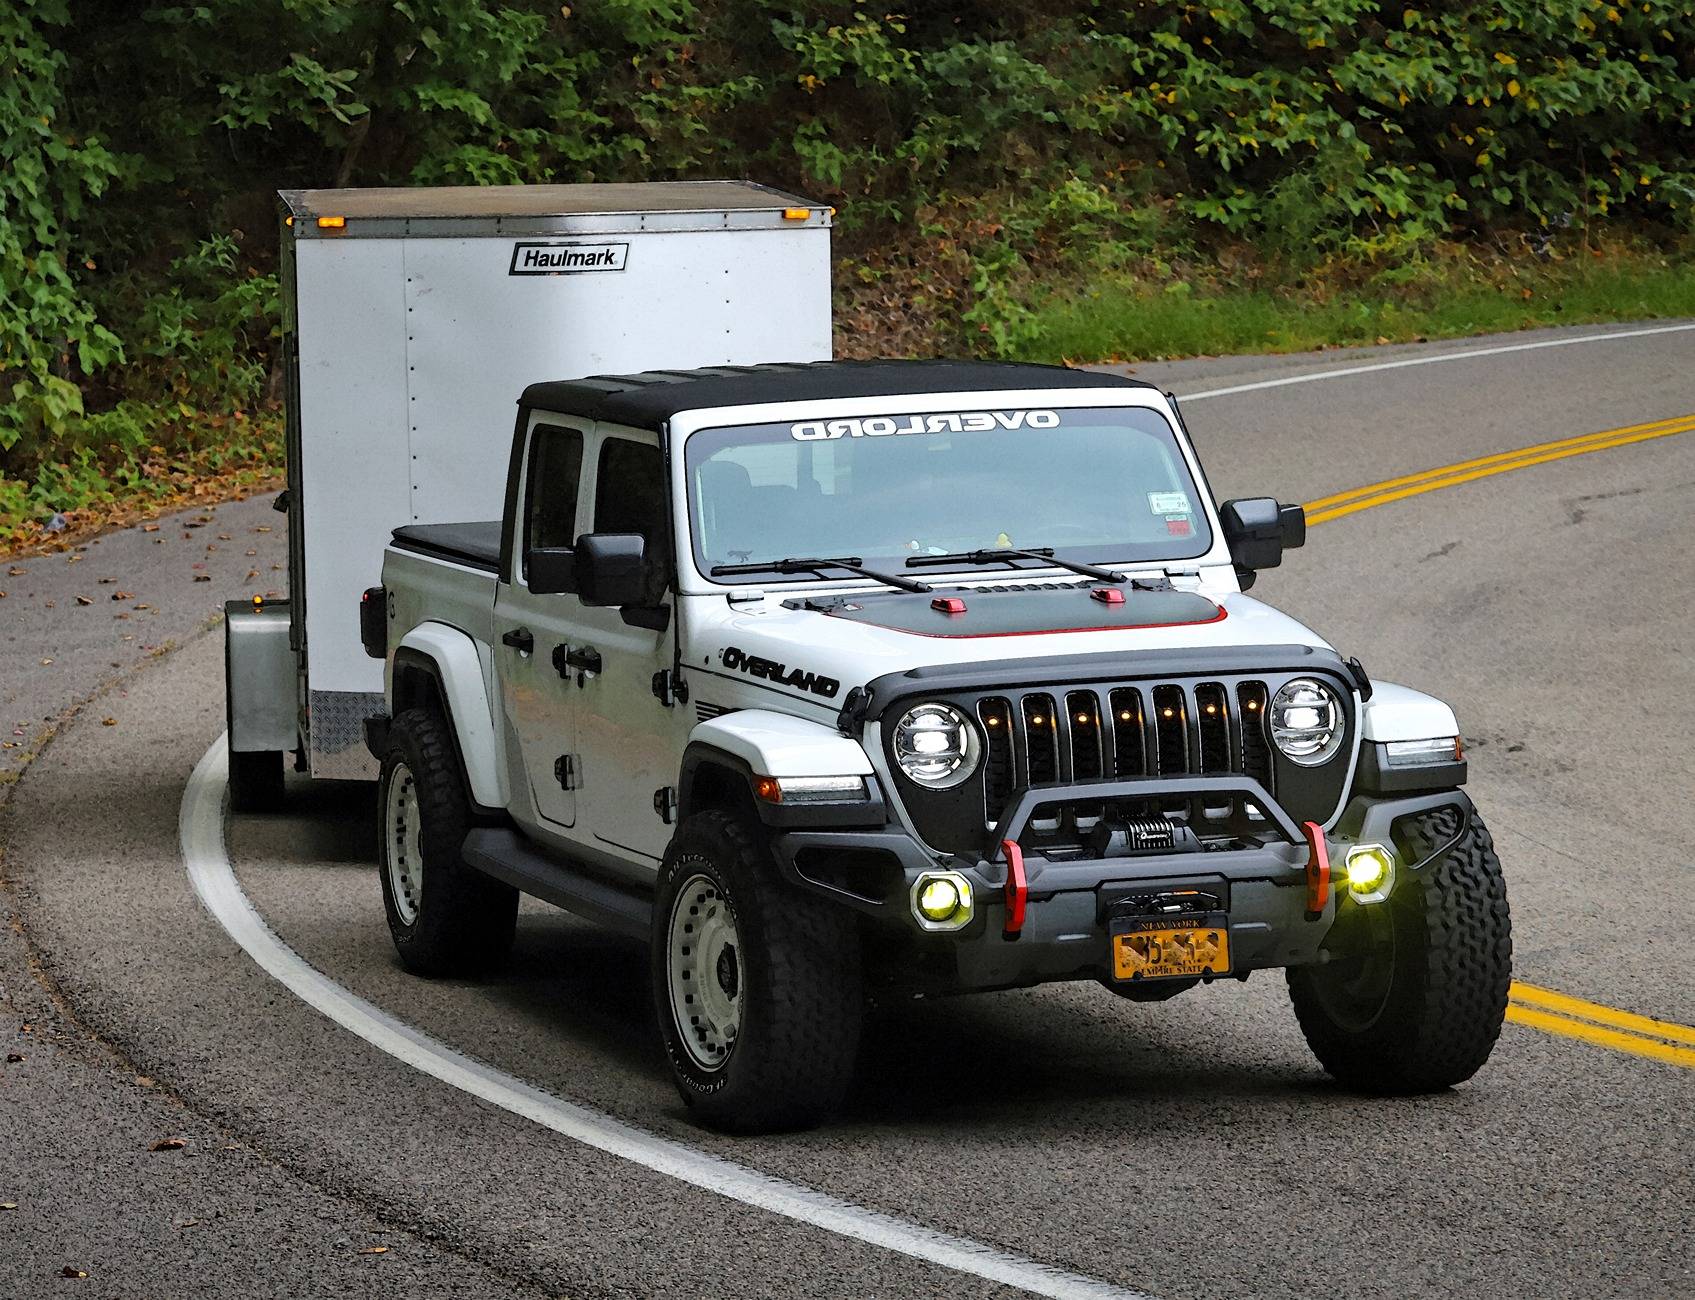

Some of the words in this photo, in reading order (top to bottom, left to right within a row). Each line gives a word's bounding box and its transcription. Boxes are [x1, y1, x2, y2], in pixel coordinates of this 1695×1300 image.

[523, 249, 615, 267] Haulmark
[722, 646, 840, 699] OVERLAND
[1140, 921, 1166, 930] NEW
[1172, 919, 1200, 929] YORK
